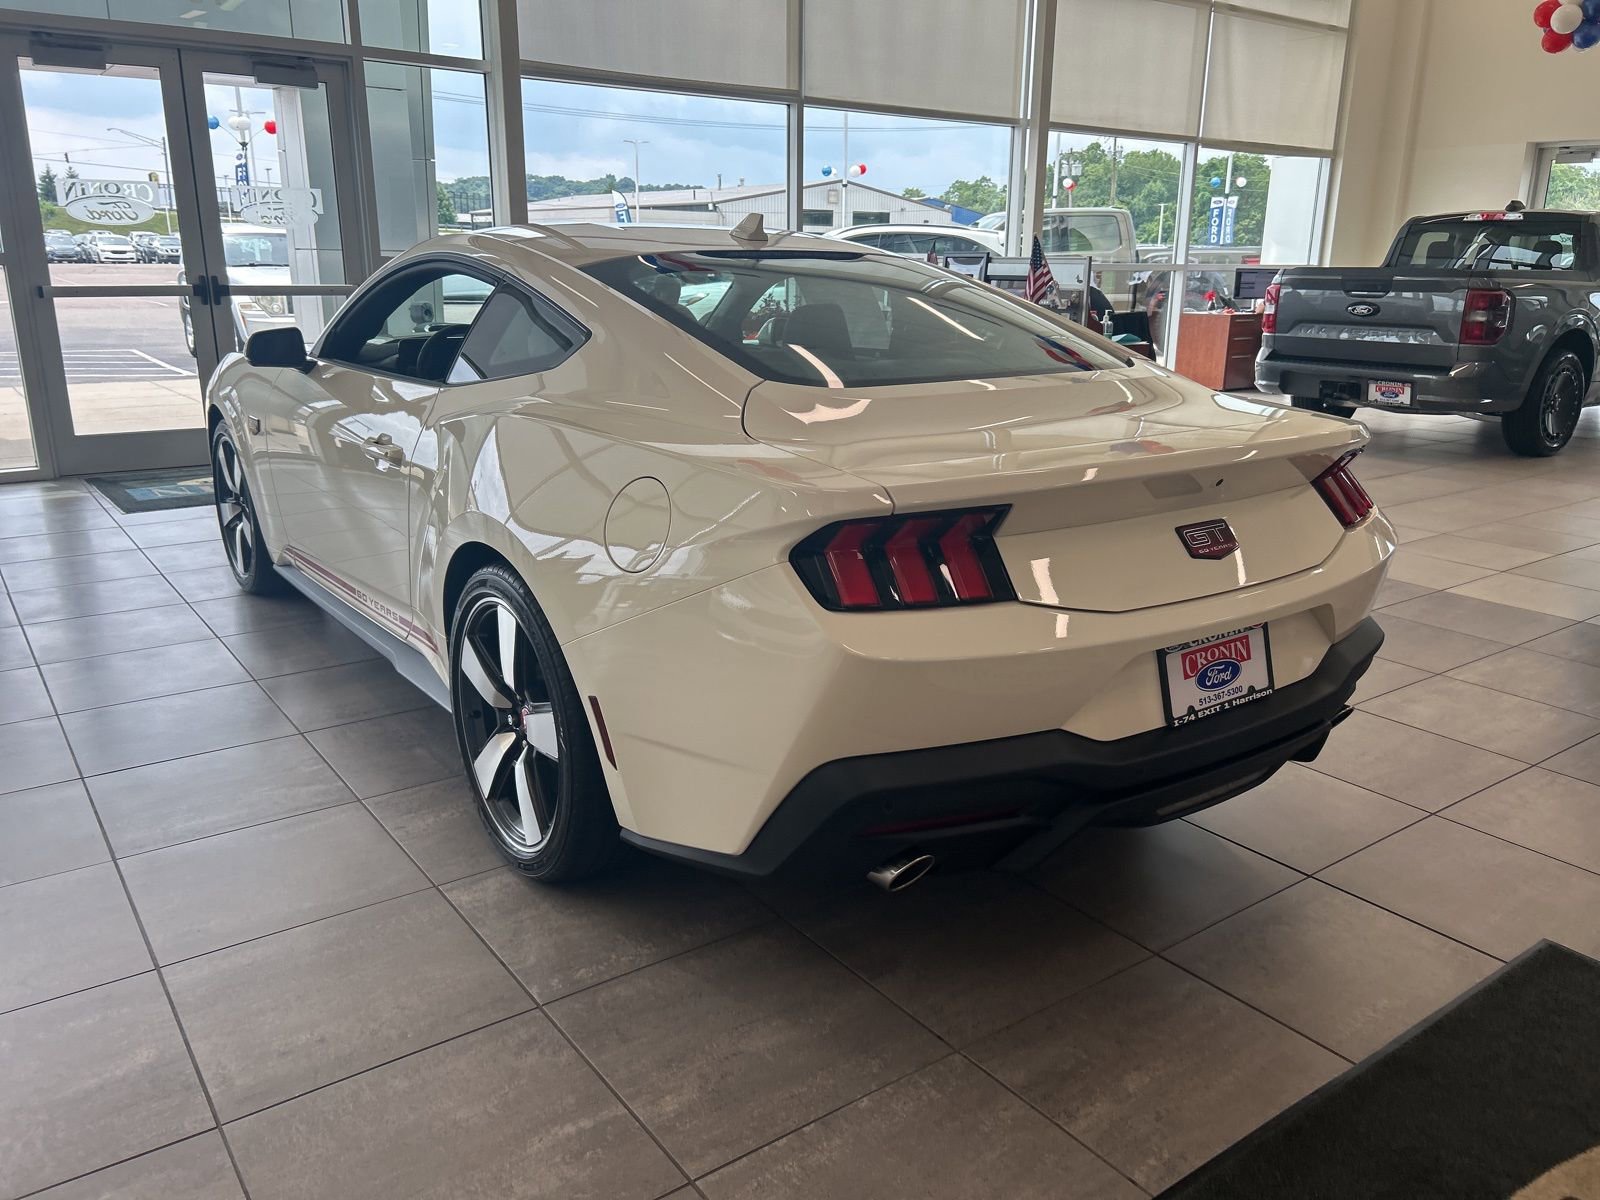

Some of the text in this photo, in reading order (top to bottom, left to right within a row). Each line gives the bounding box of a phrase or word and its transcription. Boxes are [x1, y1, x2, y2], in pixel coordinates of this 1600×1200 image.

[1211, 208, 1220, 243] FORD
[1376, 386, 1404, 394] CRONIN
[1183, 522, 1226, 548] GT
[1211, 543, 1233, 552] YEARS
[356, 589, 399, 621] 60 YEARS
[1185, 639, 1248, 677] CRONIN
[1205, 664, 1232, 686] Ford
[1173, 713, 1196, 727] I-74
[1197, 704, 1222, 718] EXIT
[1232, 688, 1273, 706] Harrison
[1198, 685, 1243, 706] 513-367-5300
